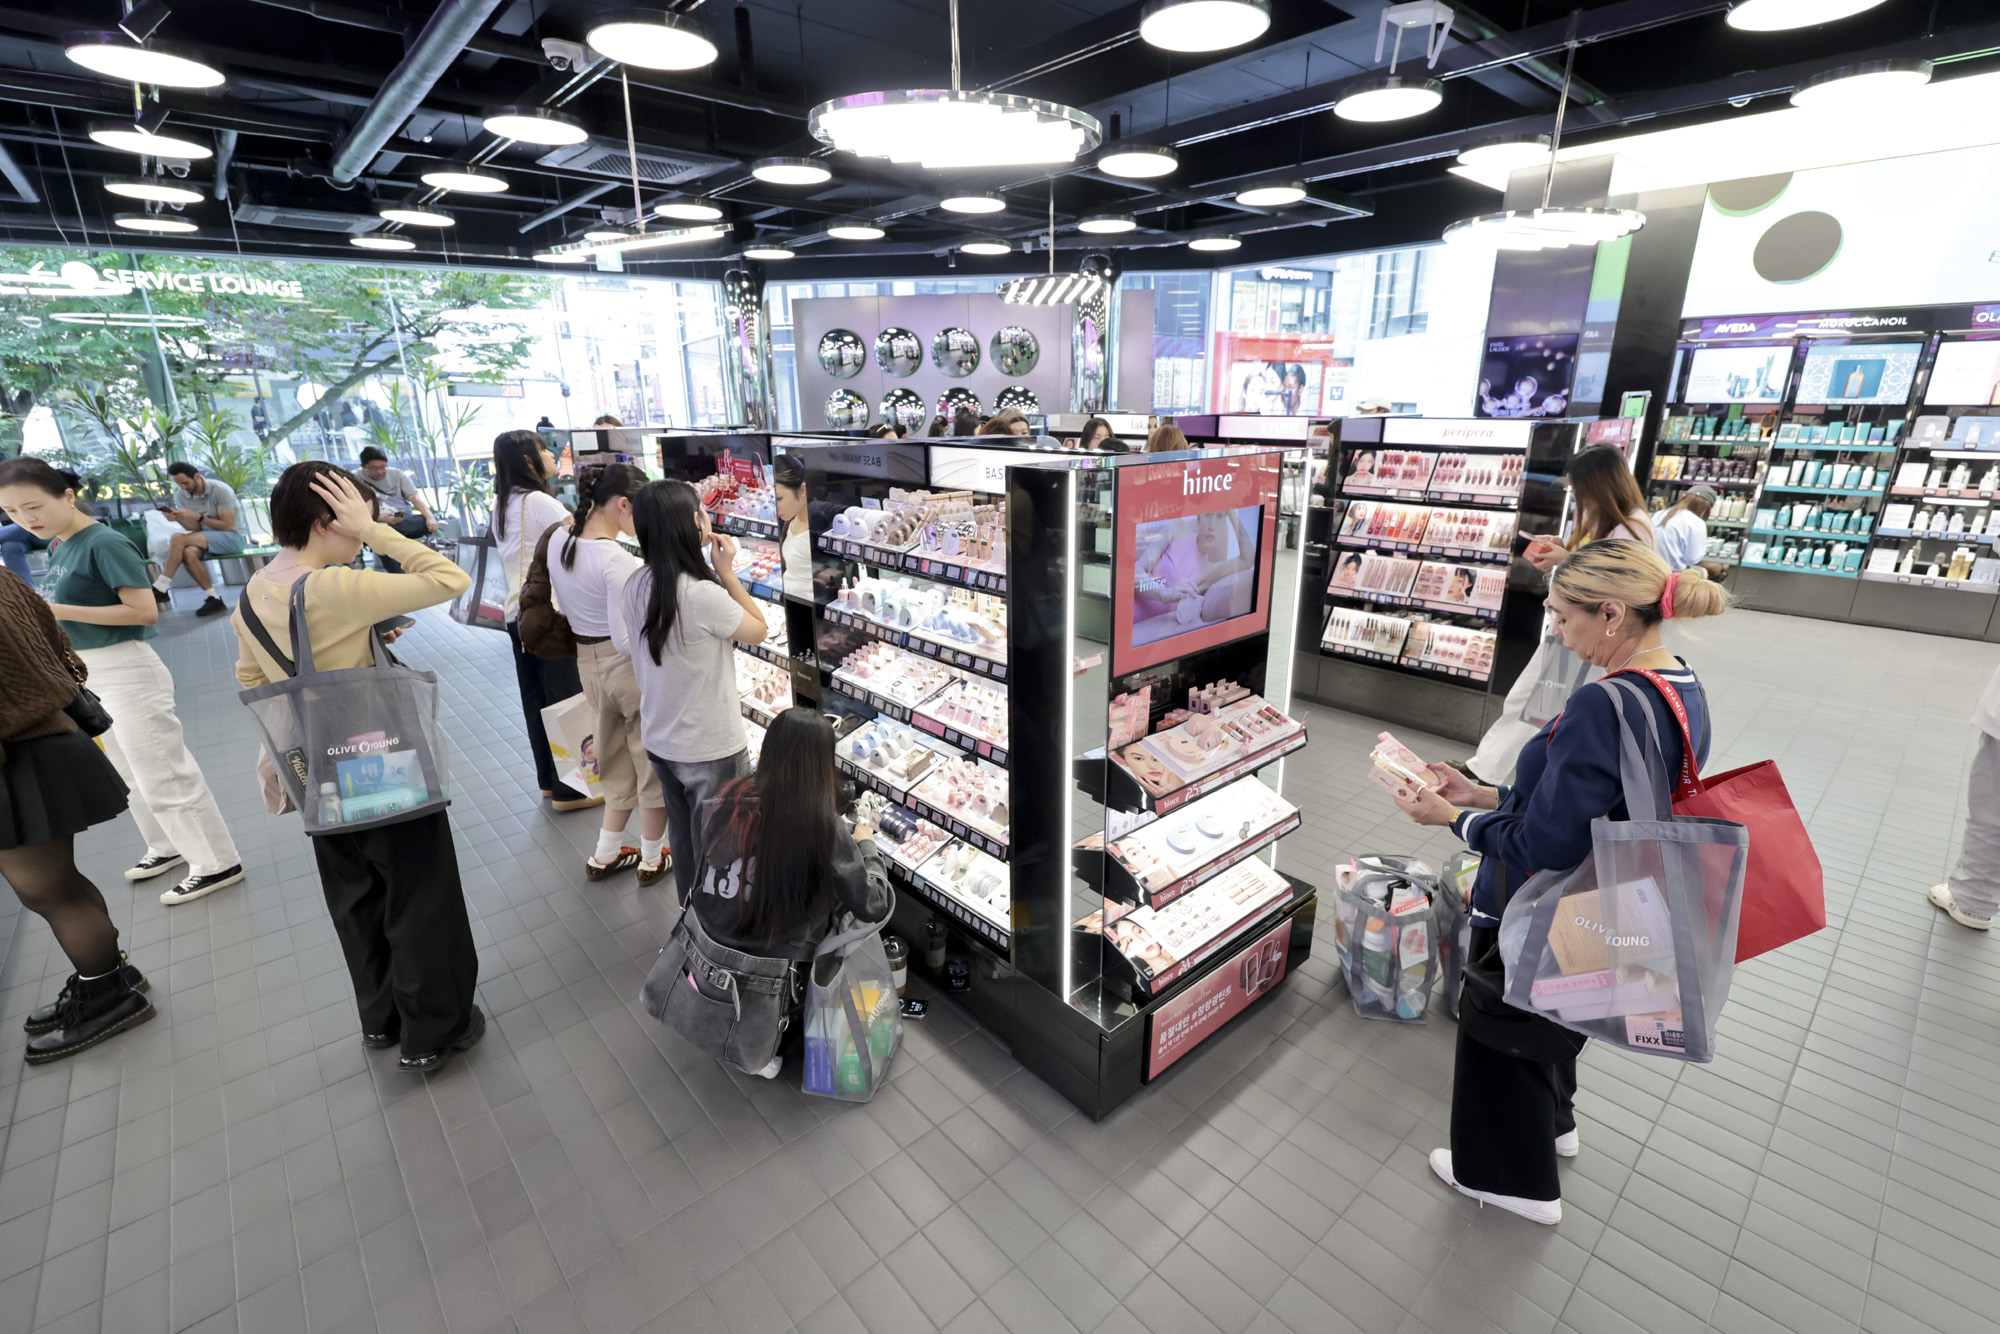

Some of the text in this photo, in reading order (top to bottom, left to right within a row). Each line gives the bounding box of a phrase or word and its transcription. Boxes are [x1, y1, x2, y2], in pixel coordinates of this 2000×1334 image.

[103, 268, 304, 298] SERVICE LOUNGE
[1714, 322, 1757, 335] AVEDA
[1819, 316, 1908, 329] MOROCCANOIL
[1260, 422, 1302, 435] ETUDE
[1442, 427, 1494, 439] peripera
[985, 467, 1006, 480] BAS
[1183, 468, 1233, 496] hince
[1139, 577, 1166, 593] hince
[327, 737, 400, 756] OLIVE YOUNG
[1682, 753, 1692, 785] TIRTIR
[1163, 796, 1180, 809] hince
[1159, 888, 1176, 903] hince
[1574, 916, 1606, 934] OLIV
[1605, 936, 1650, 947] YOUNG
[1158, 972, 1174, 987] hince
[877, 987, 891, 1007] YOUNG
[1635, 1035, 1661, 1046] FIXX
